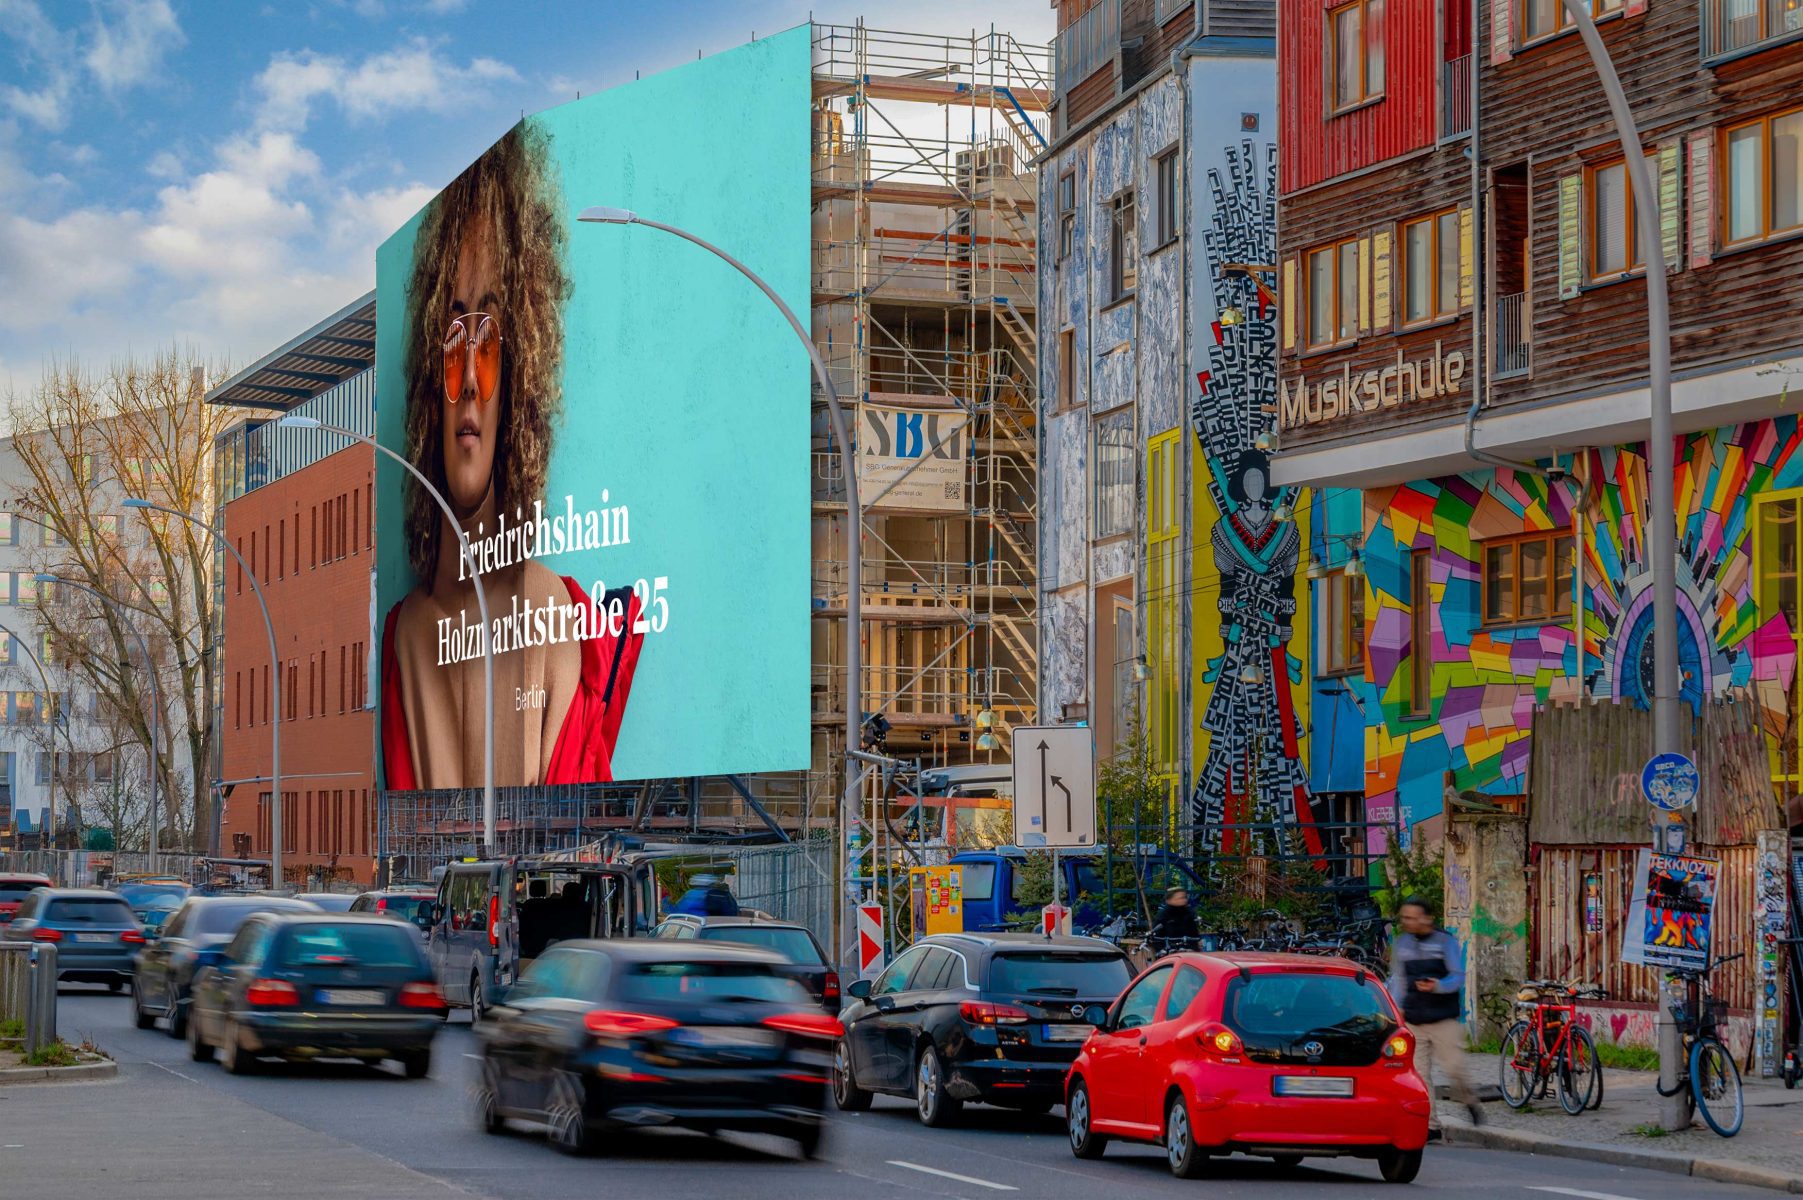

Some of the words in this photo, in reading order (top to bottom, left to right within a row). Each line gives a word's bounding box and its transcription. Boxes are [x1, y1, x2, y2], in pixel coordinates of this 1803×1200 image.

[1280, 339, 1465, 428] Musikschule
[458, 488, 631, 582] Friedrichshain
[632, 576, 670, 635] 25
[515, 685, 546, 711] Berlin
